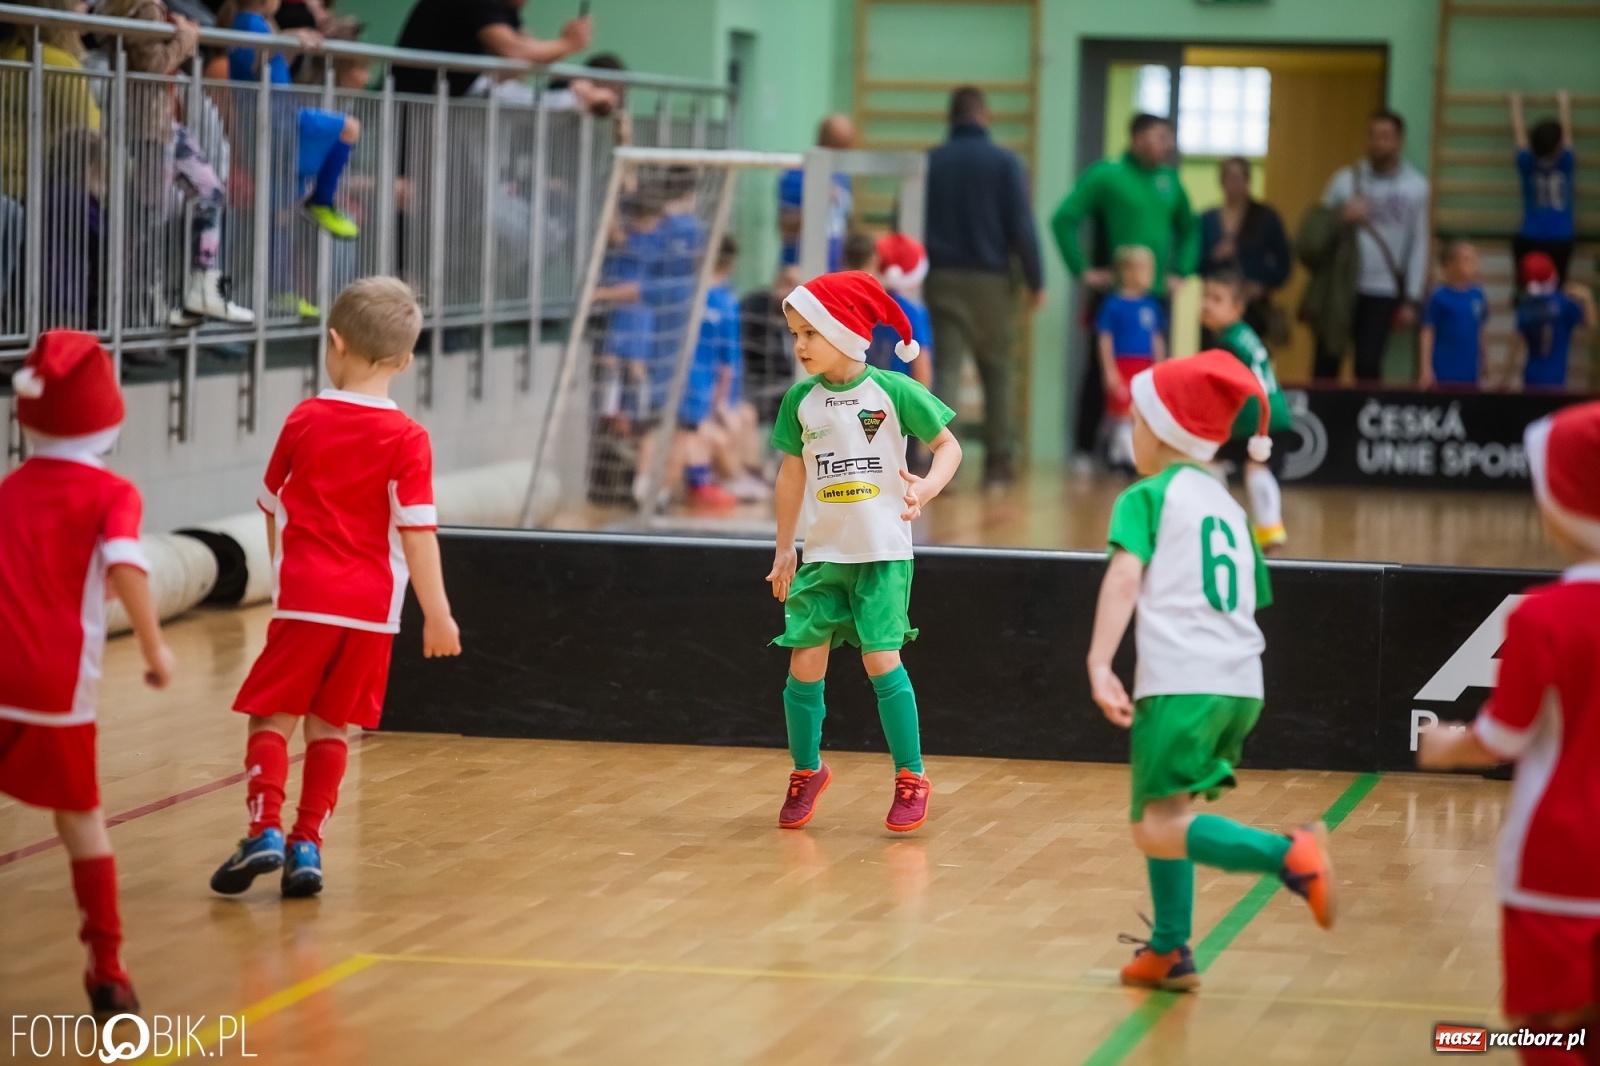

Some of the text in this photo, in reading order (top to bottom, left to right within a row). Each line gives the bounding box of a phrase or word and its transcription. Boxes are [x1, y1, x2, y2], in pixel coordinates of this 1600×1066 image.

[1357, 441, 1529, 478] UNIE SPOR
[823, 485, 873, 499] inter service
[1201, 516, 1237, 612] 6
